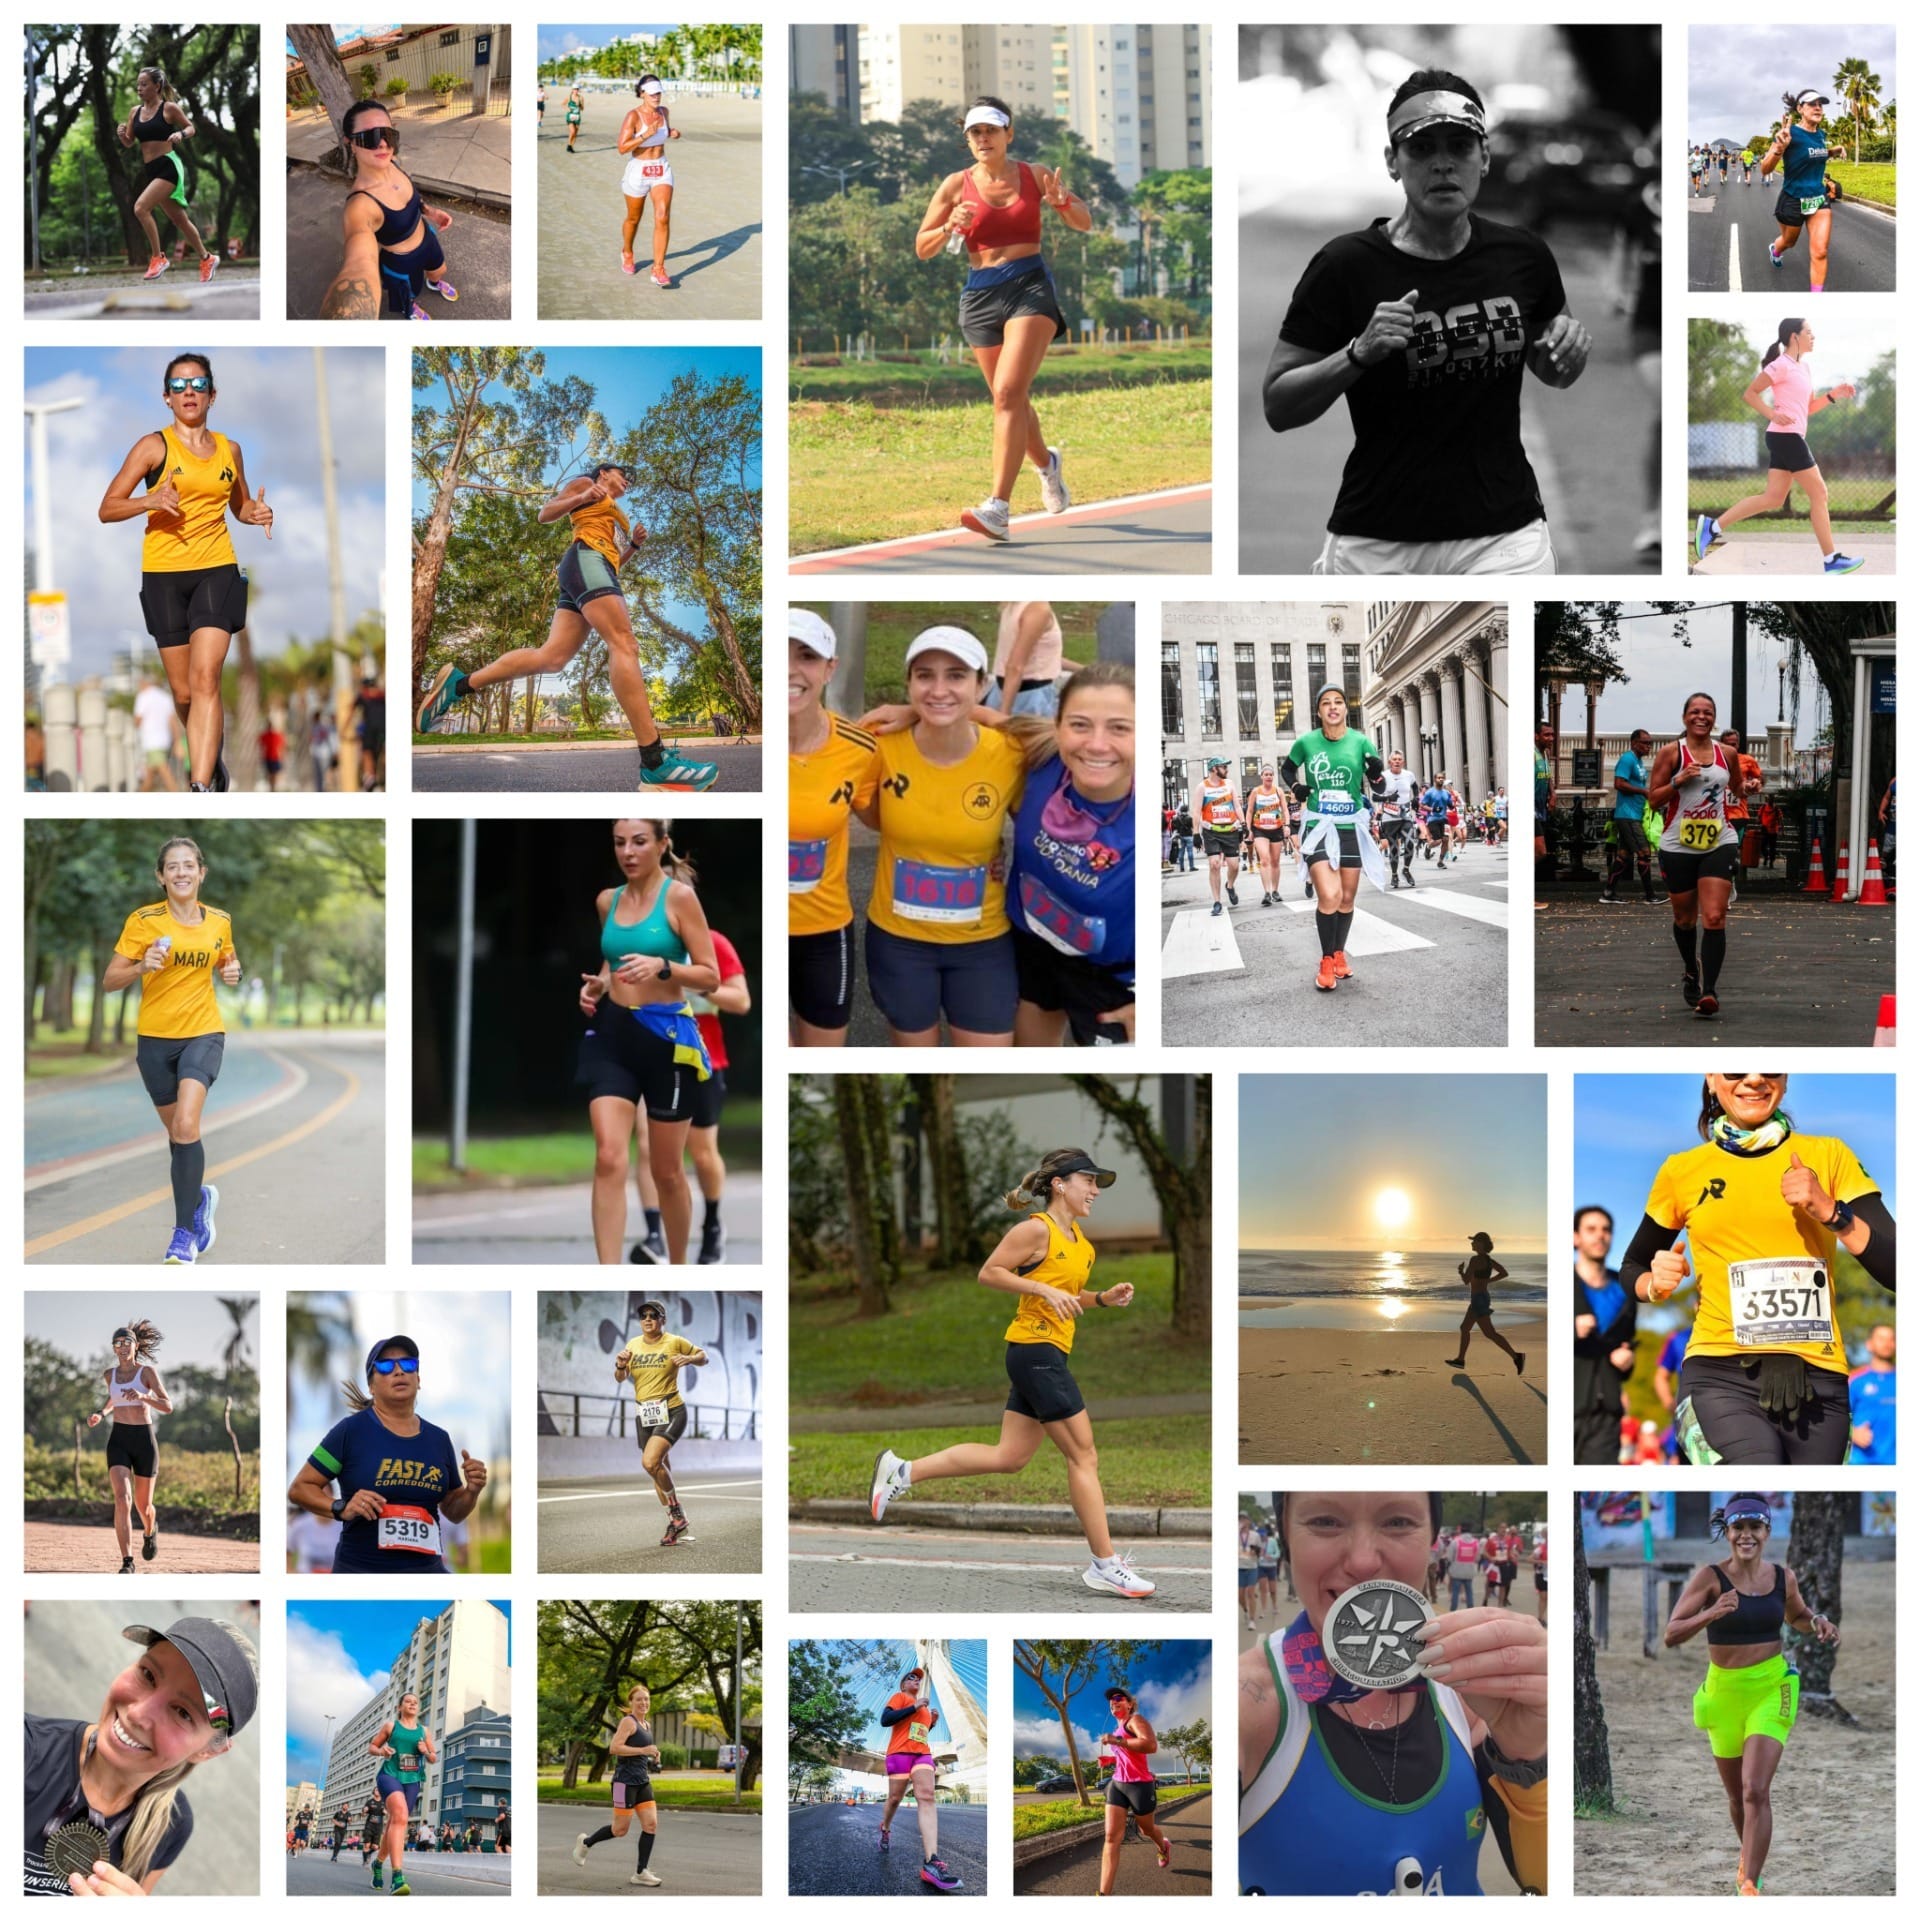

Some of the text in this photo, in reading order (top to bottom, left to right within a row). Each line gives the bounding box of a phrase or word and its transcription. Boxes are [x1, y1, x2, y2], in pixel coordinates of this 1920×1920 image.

[1326, 803, 1354, 813] 46091
[1684, 824, 1718, 845] 379
[174, 951, 210, 968] MARI
[1743, 1288, 1821, 1321] 33571
[642, 1406, 661, 1417] 2176
[376, 1458, 425, 1480] FAST
[375, 1479, 443, 1493] CORREDORES
[385, 1519, 429, 1540] 5319
